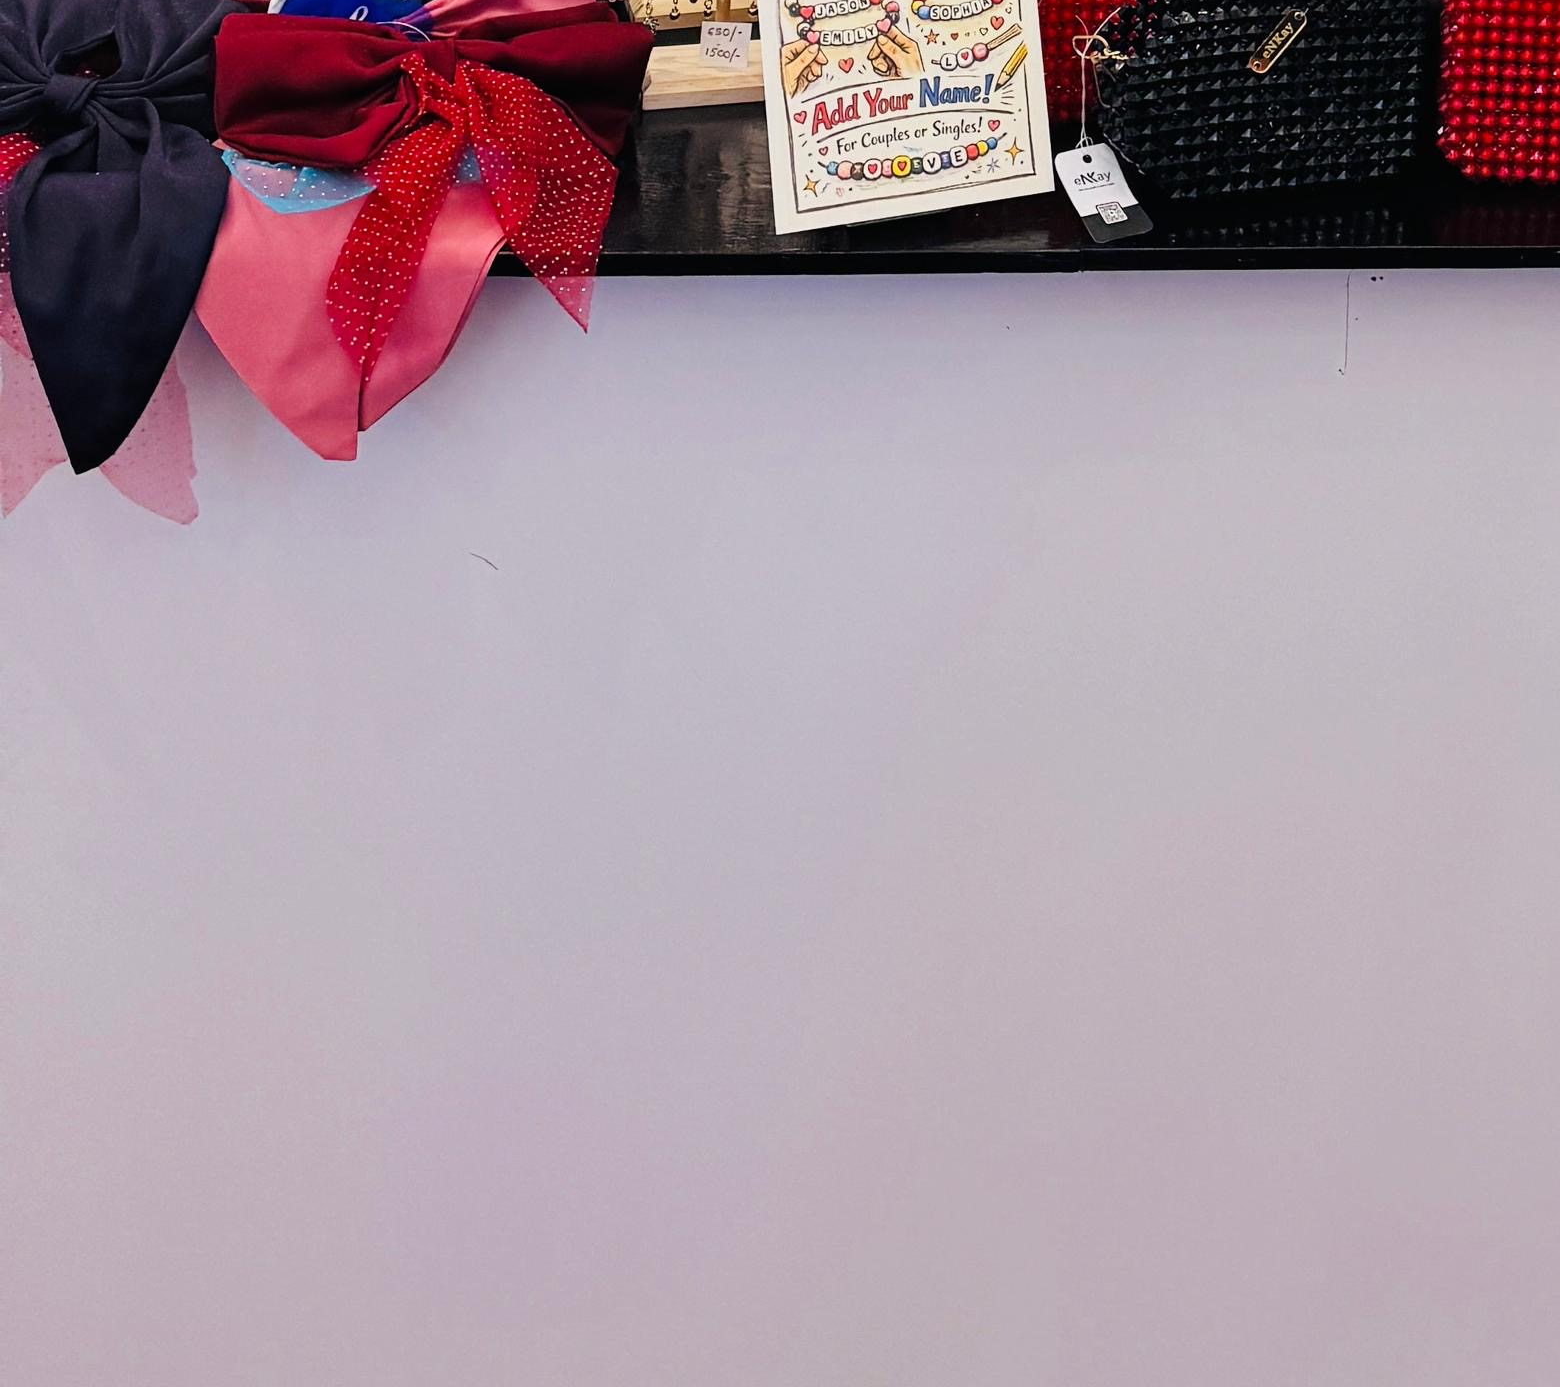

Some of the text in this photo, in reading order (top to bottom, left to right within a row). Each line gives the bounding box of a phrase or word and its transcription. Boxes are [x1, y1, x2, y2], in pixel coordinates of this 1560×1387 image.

[821, 28, 877, 44] EMILY
[1263, 22, 1294, 59] eNKay
[811, 74, 994, 135] Add Your Name!
[836, 117, 982, 155] For Couples or Singles!
[1074, 171, 1111, 186] eNKay
